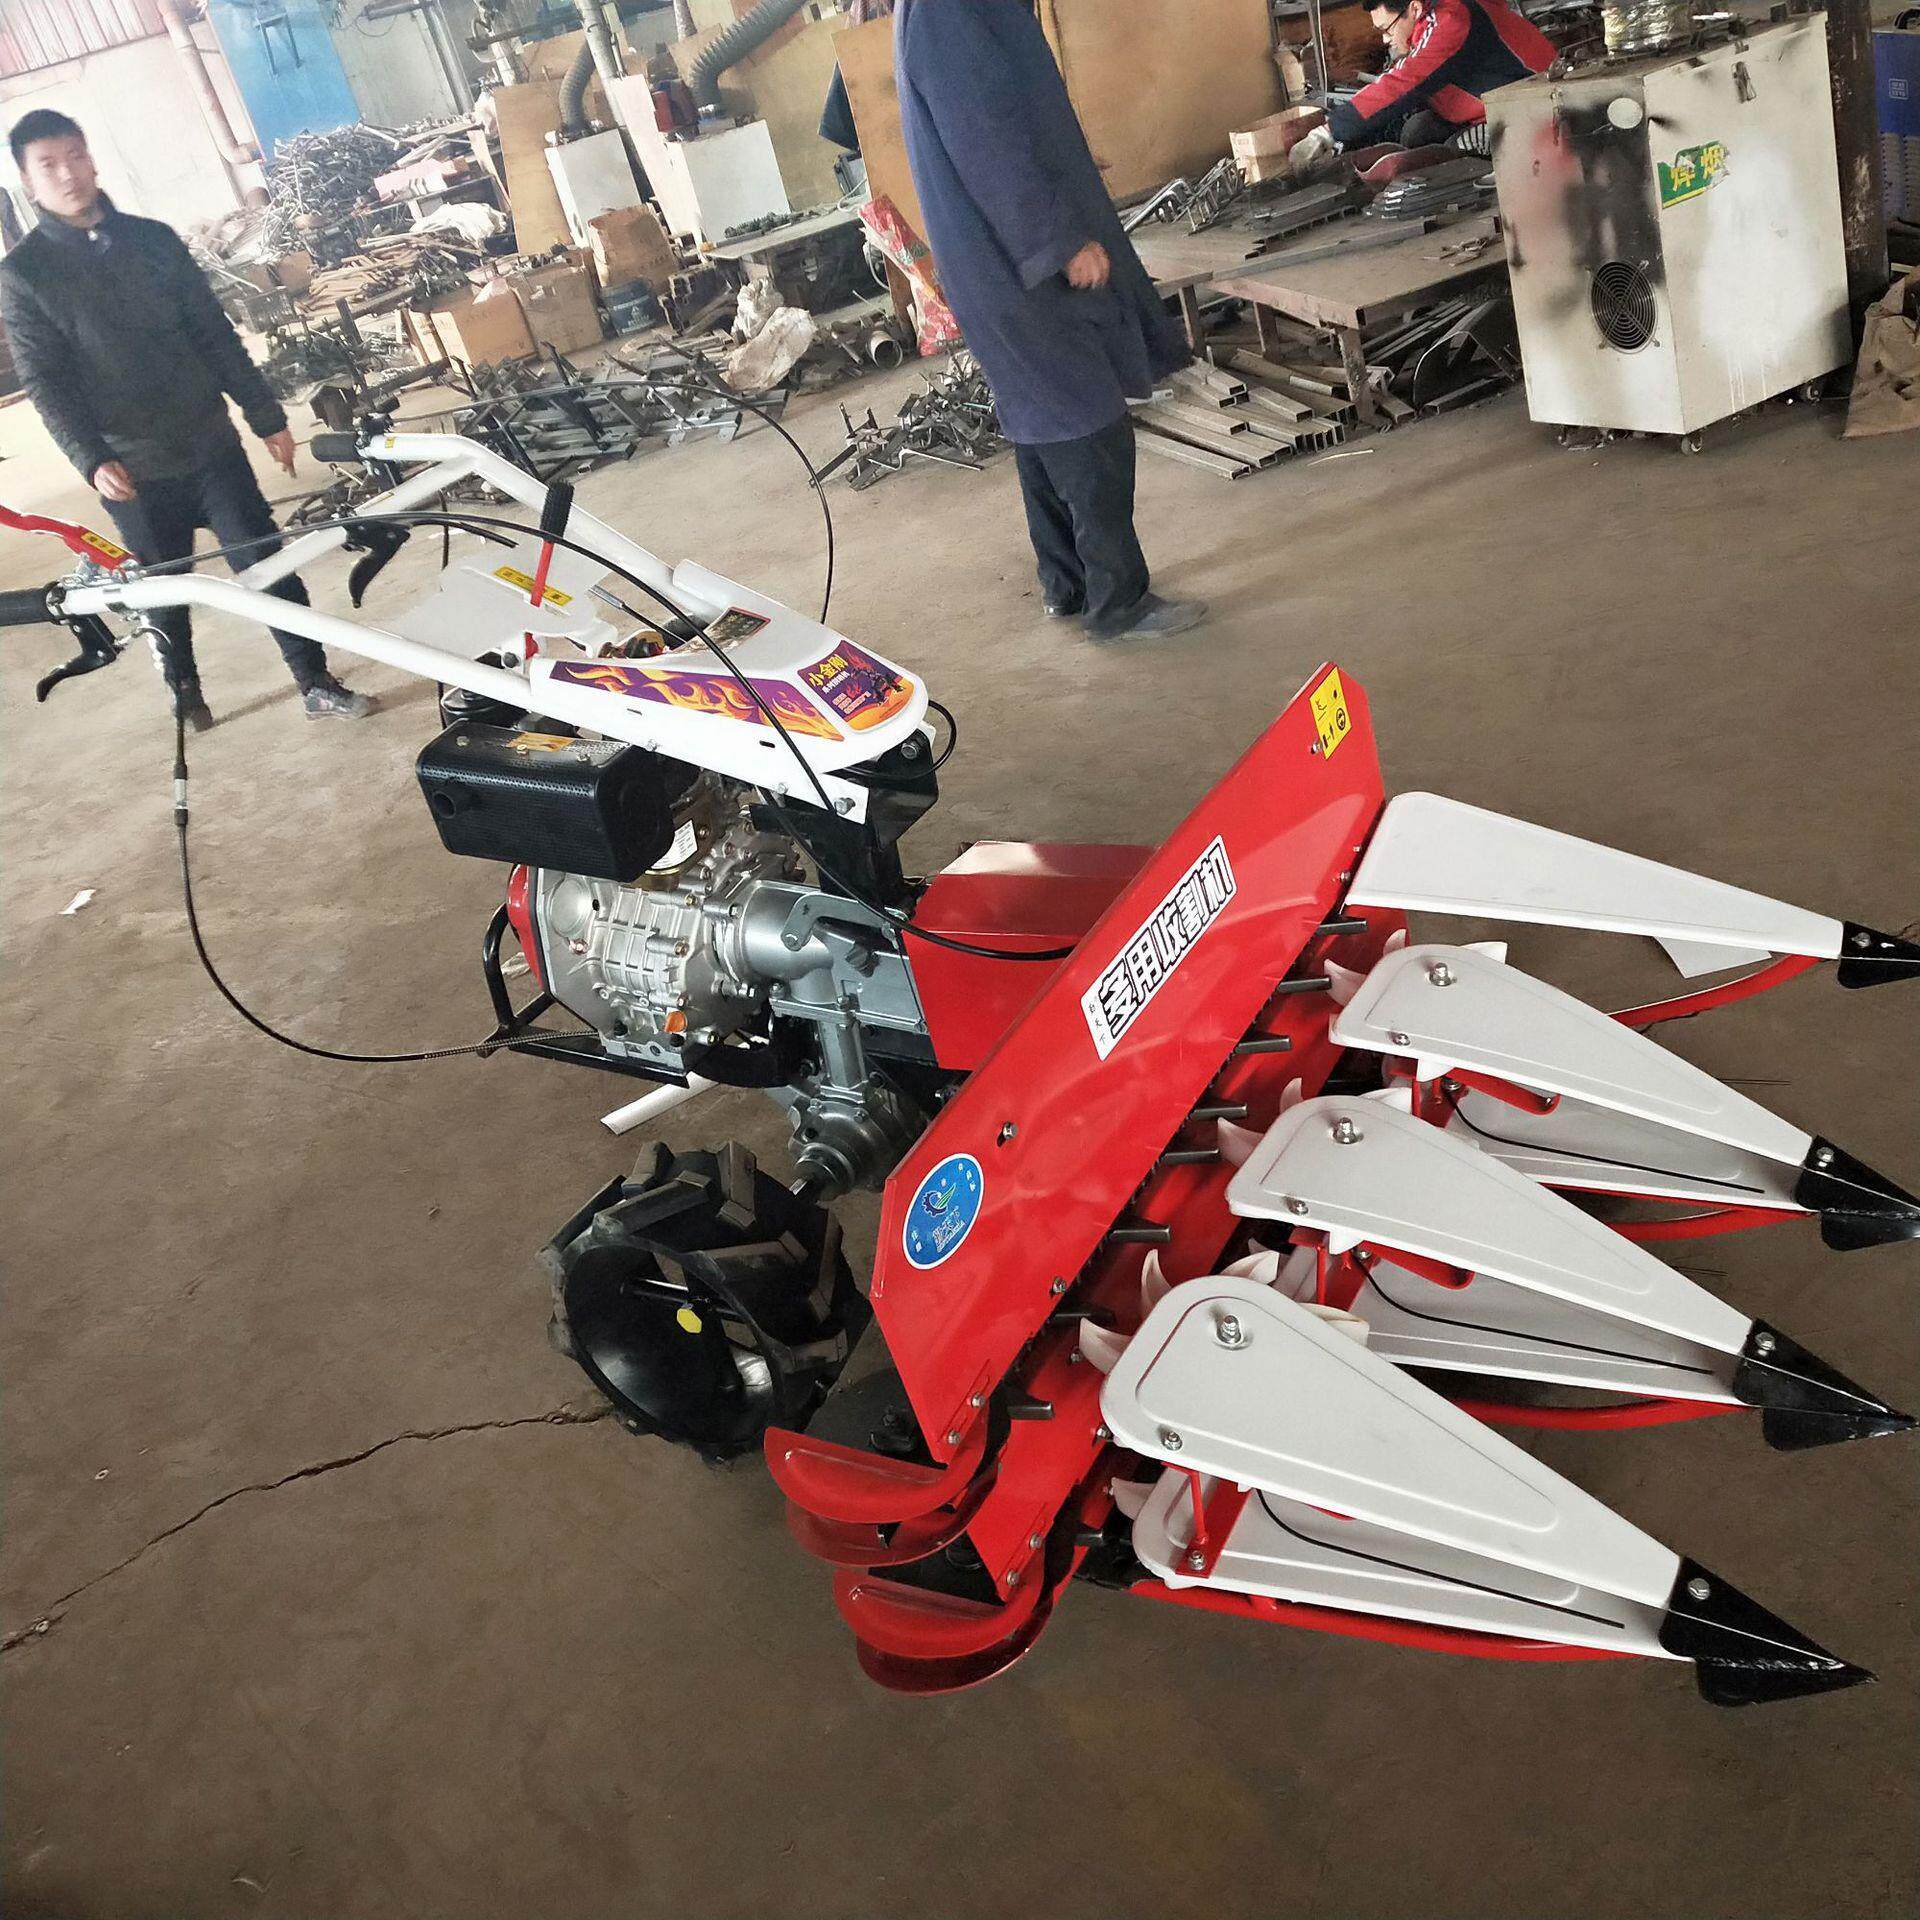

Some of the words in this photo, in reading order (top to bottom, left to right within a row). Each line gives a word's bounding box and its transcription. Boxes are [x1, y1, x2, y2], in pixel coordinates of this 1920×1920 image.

[808, 654, 849, 687] 小金刚
[1098, 842, 1233, 1039] 多用收割机
